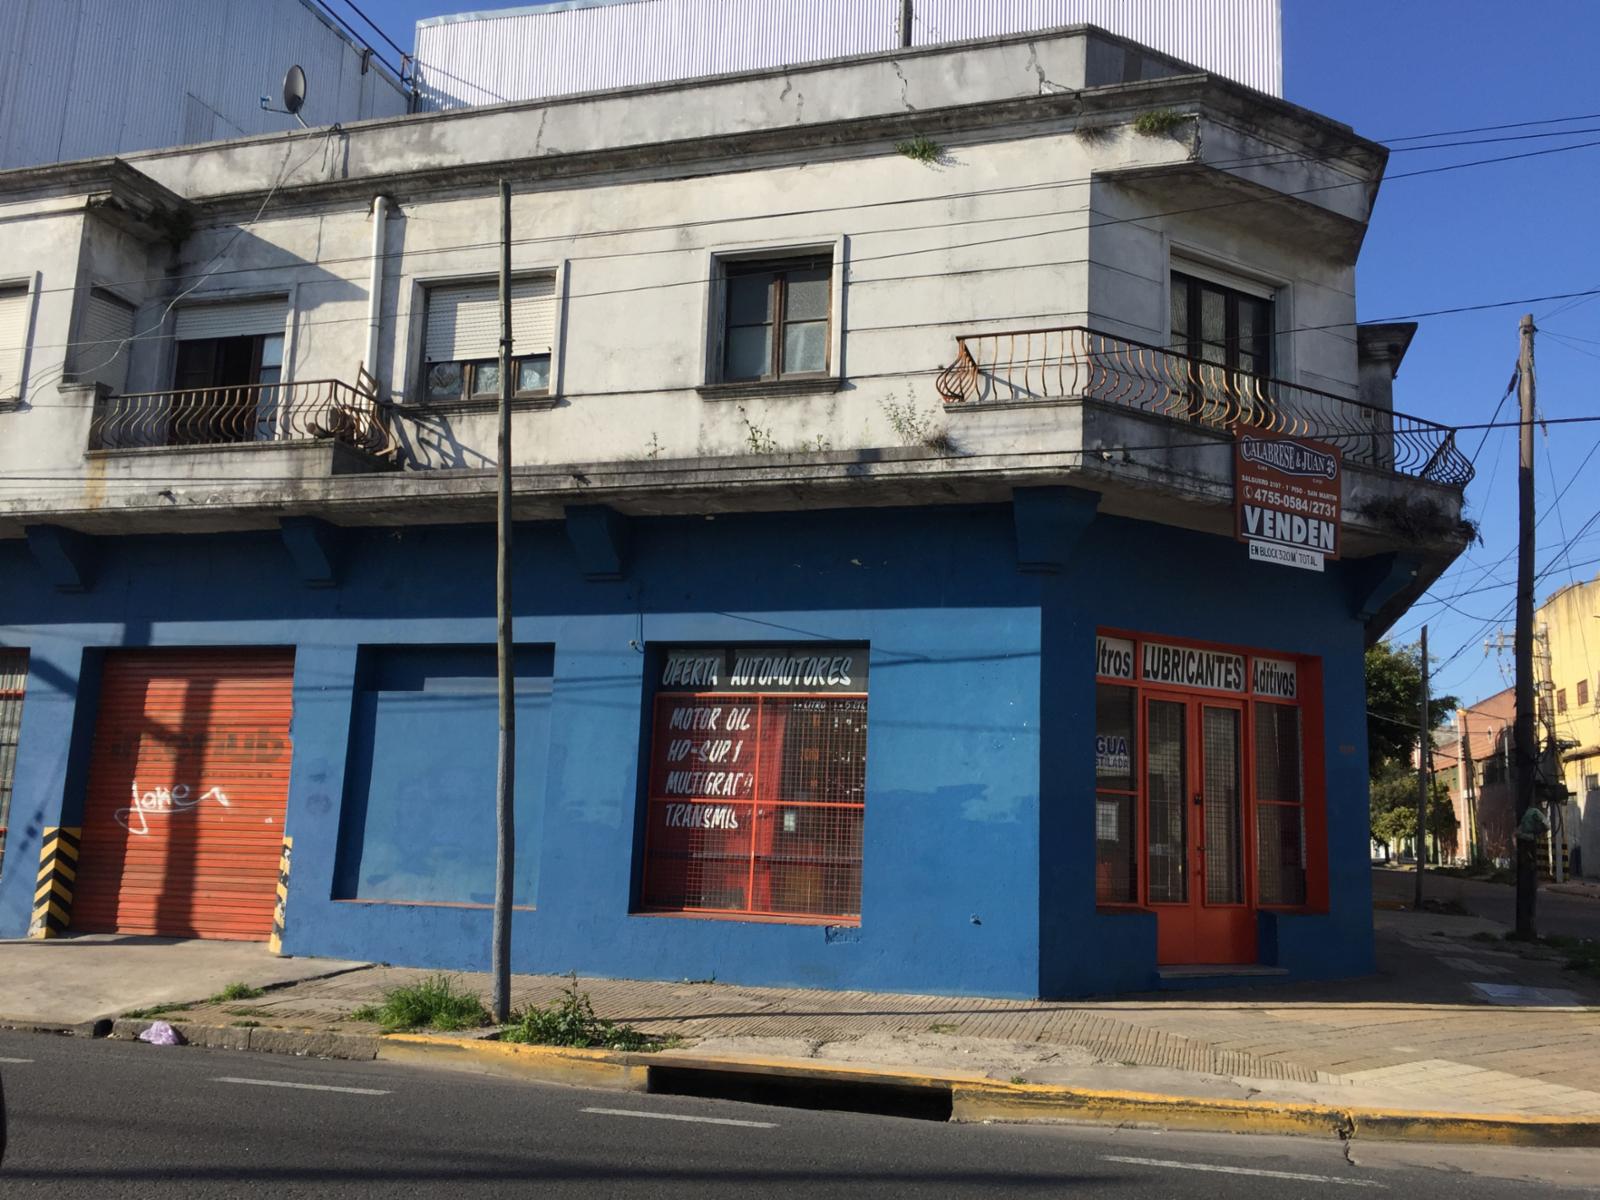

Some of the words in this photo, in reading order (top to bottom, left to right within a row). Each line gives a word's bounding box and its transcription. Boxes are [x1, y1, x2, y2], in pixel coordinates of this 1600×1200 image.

[1243, 438, 1295, 470] CALABRESE
[1296, 453, 1302, 468] &
[1302, 451, 1326, 472] JUAN
[1244, 504, 1335, 550] VENDEN
[1250, 544, 1259, 556] EN
[1298, 552, 1318, 567] TOTAL
[662, 657, 719, 687] OFERTA
[730, 656, 854, 687] AUTOMOTORES
[1142, 644, 1243, 691] LUBRICANTES
[1252, 660, 1296, 697] Aditivos
[669, 707, 724, 731] MOTOR
[725, 707, 752, 731] OIL
[1096, 735, 1128, 755] GUA
